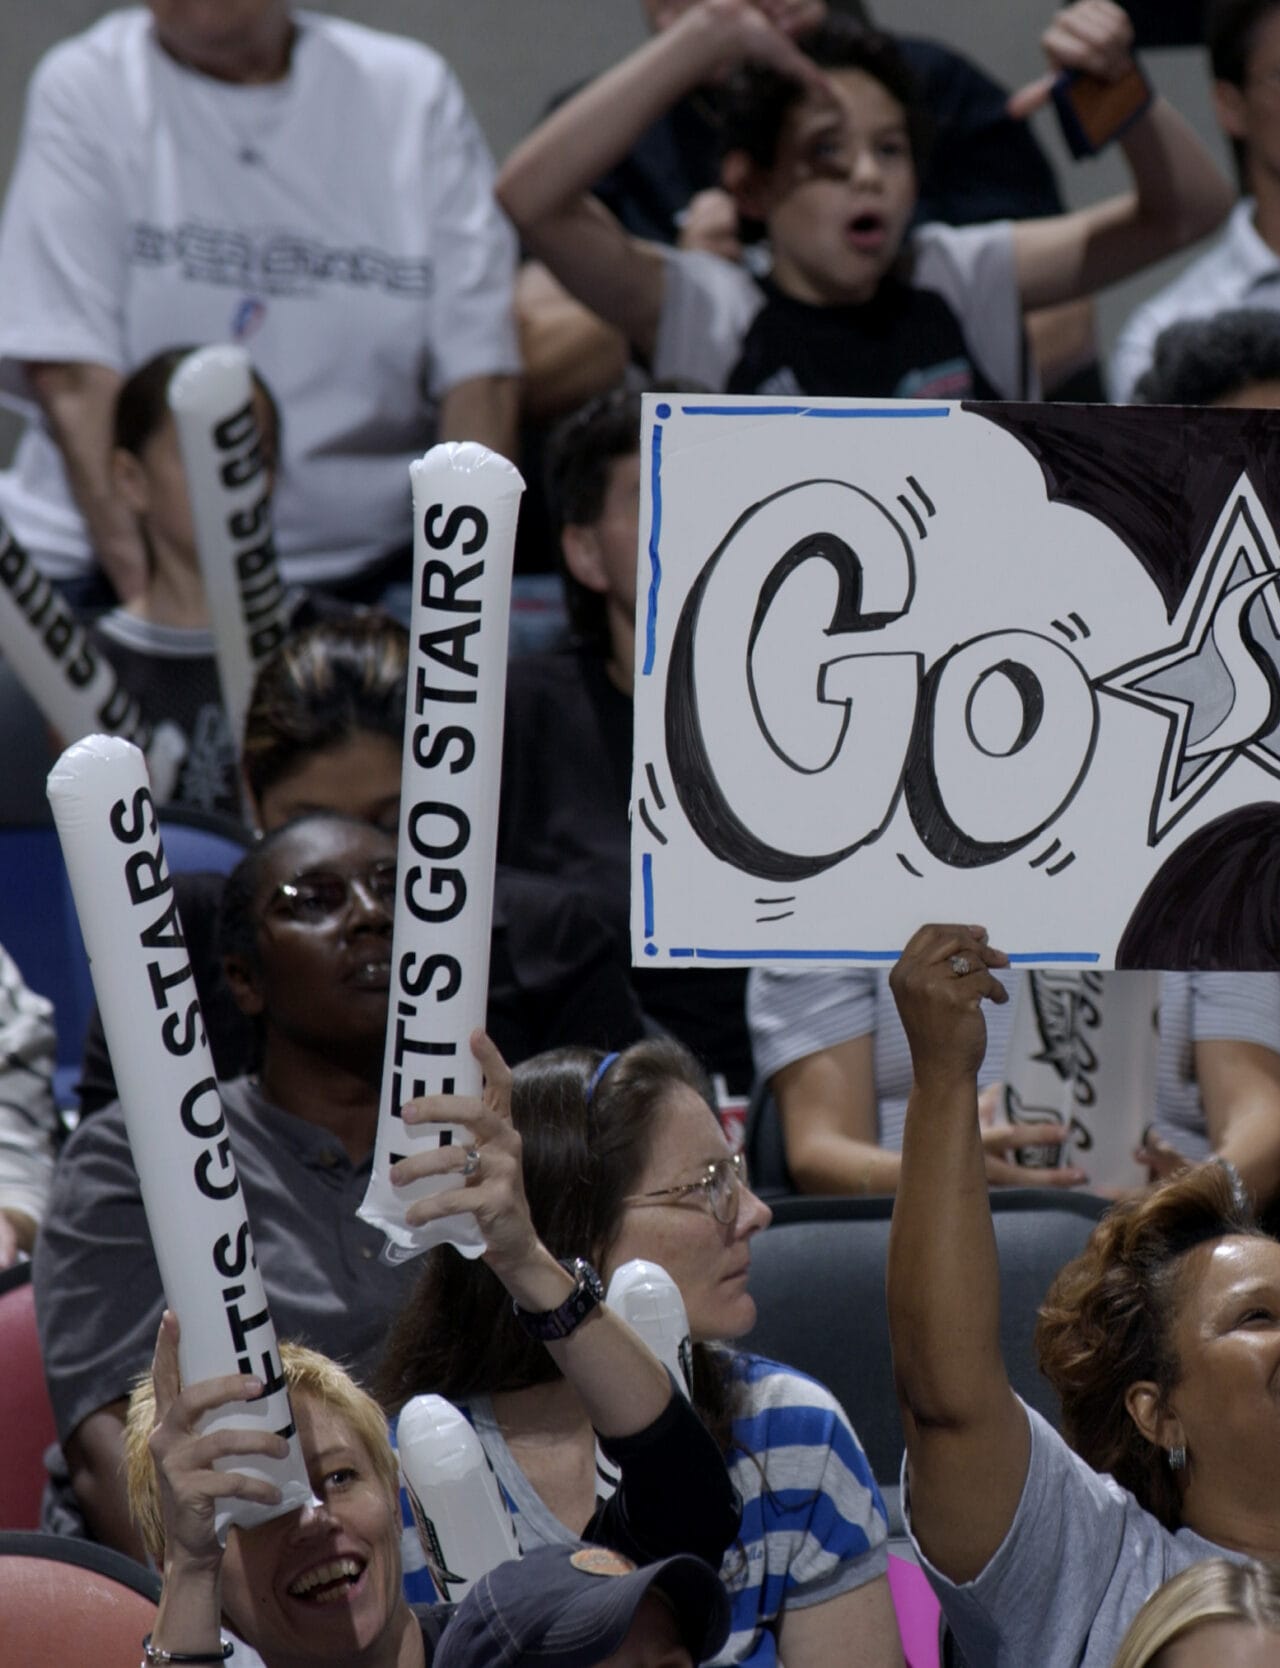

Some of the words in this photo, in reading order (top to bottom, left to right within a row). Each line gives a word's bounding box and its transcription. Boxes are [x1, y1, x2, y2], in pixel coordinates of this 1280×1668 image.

[412, 503, 488, 775] STARS
[110, 787, 207, 1056] STARS
[405, 801, 471, 923] GO
[180, 1076, 239, 1200] GO
[213, 1221, 295, 1439] ET'S
